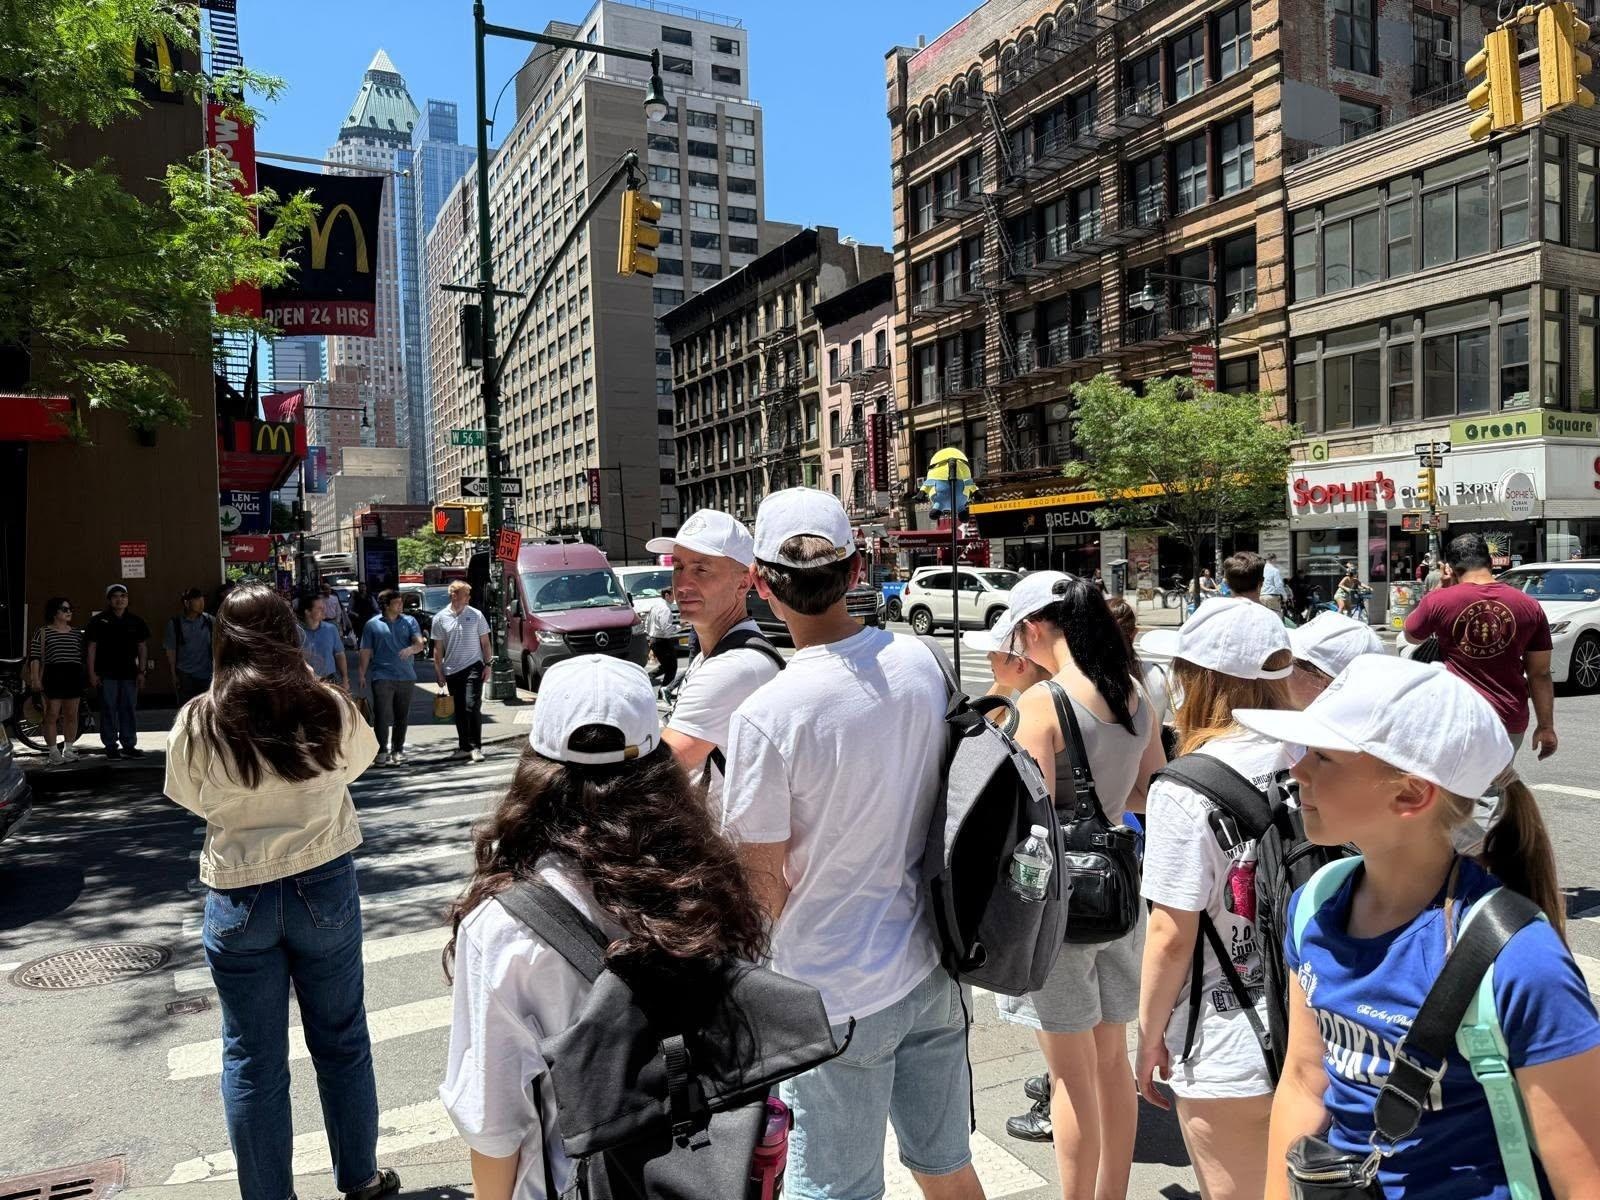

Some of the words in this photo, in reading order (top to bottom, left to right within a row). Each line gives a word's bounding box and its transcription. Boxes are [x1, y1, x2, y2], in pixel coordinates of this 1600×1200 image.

[265, 307, 305, 326] OPEN
[310, 307, 332, 325] 24
[336, 306, 369, 327] HRS
[1465, 420, 1527, 440] Green
[1547, 415, 1593, 434] Square
[452, 431, 460, 444] W
[462, 432, 474, 444] 56
[473, 482, 488, 492] ONE
[1293, 471, 1396, 507] SOPHIE'S
[1454, 481, 1500, 496] EXPRE
[1505, 487, 1535, 500] SOPHIE'S
[1458, 603, 1512, 624] VOYAGER
